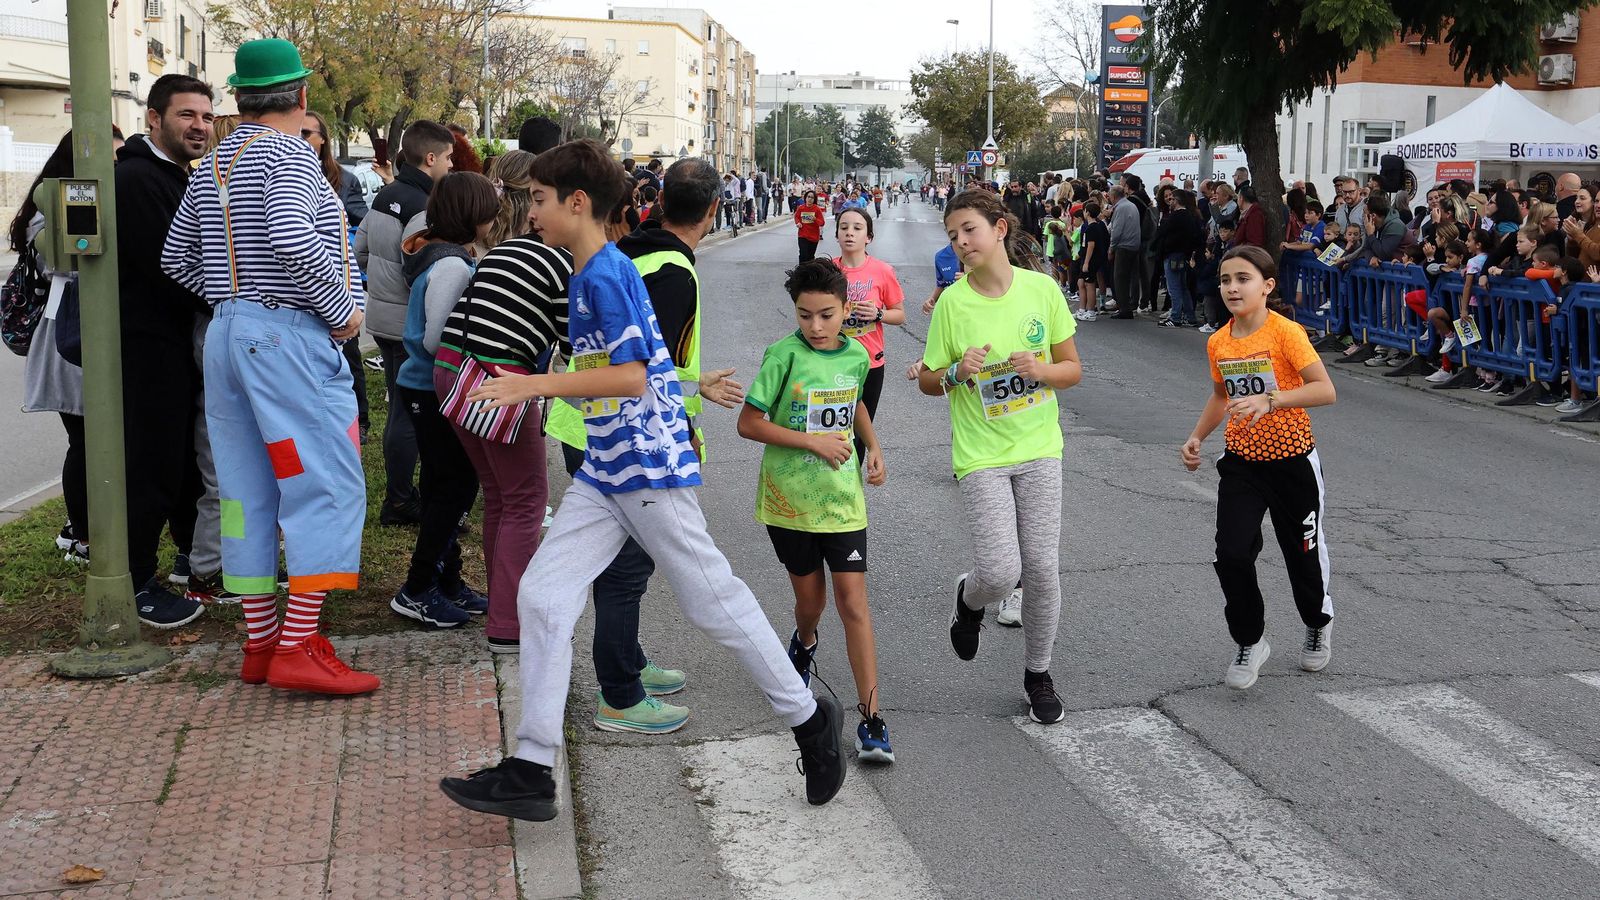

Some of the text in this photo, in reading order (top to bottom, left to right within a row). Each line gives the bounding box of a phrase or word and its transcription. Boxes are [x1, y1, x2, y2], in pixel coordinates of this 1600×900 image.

[1397, 143, 1457, 159] BOMBEROS
[1527, 148, 1584, 157] TIENDA
[1225, 376, 1265, 397] 030
[814, 390, 835, 398] CARRERA
